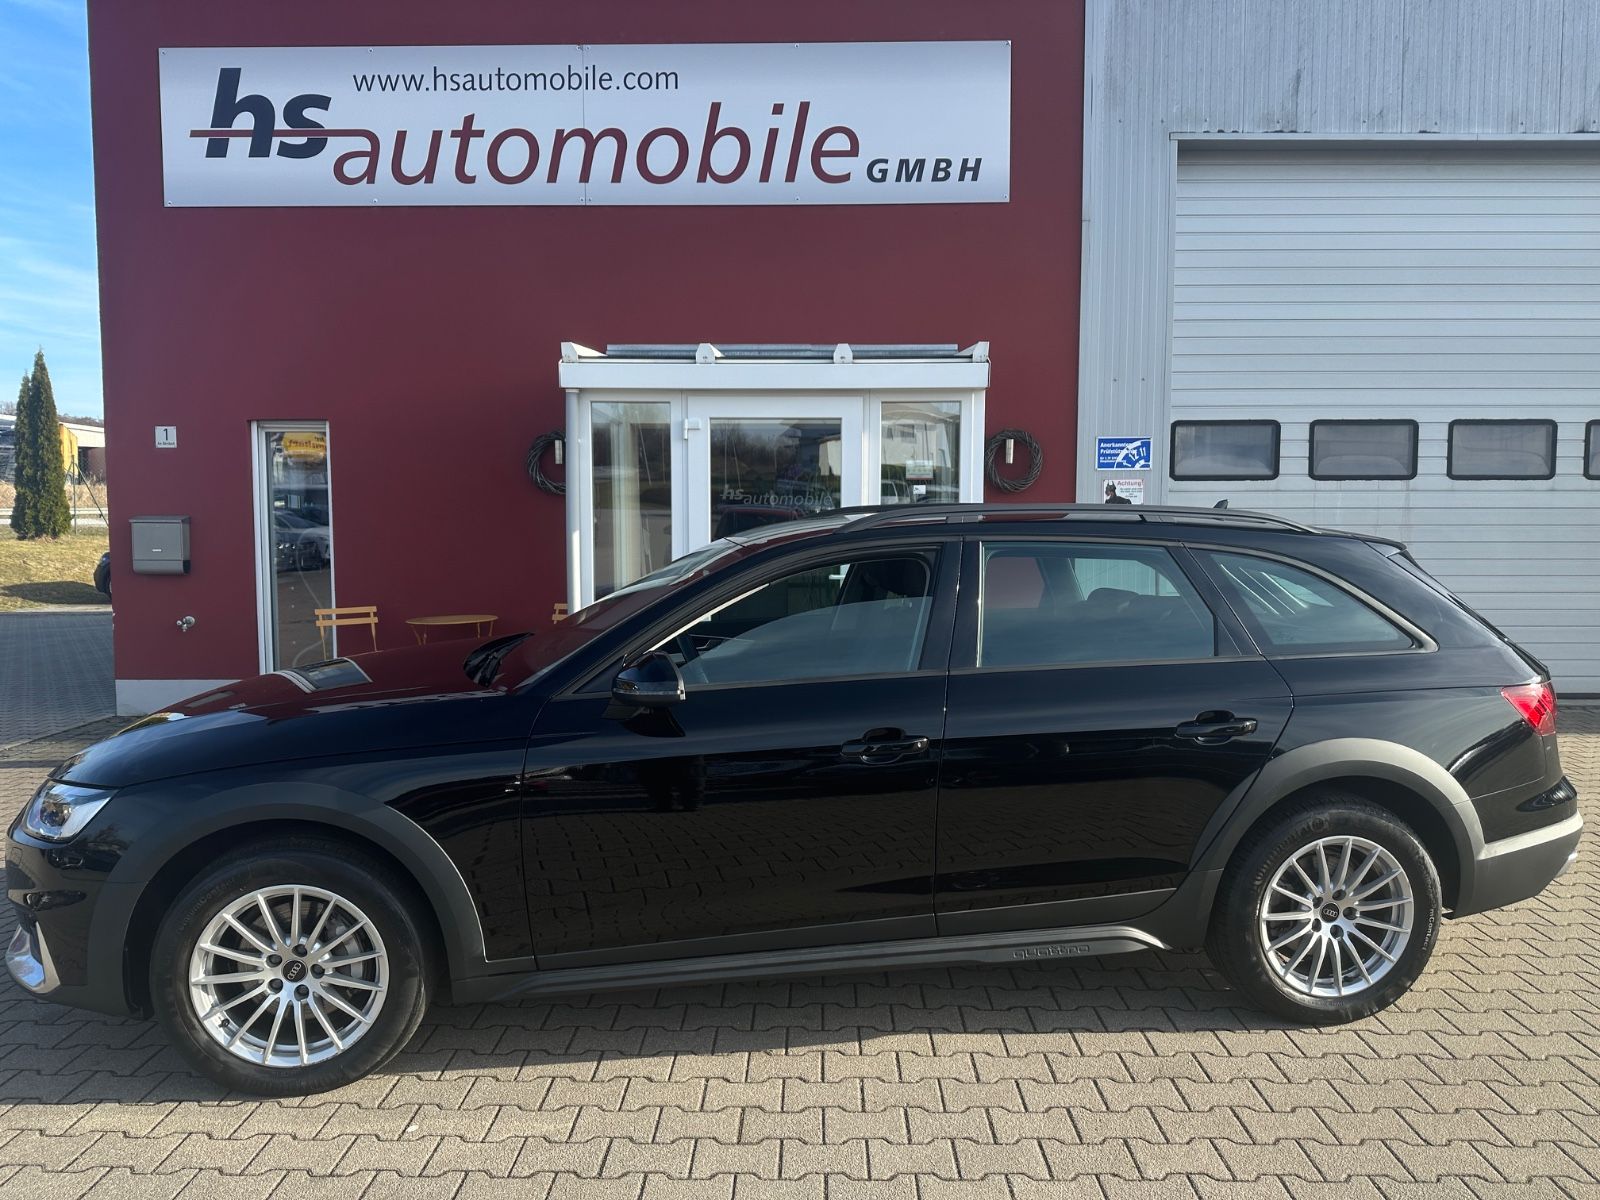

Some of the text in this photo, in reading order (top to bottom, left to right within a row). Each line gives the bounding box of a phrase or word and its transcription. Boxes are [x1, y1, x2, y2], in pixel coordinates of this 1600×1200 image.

[353, 64, 679, 92] www.hsautomobile.com
[205, 68, 983, 185] hs automobile GMBH
[163, 428, 168, 441] 1
[744, 491, 833, 506] automobile
[1009, 944, 1090, 960] quattro
